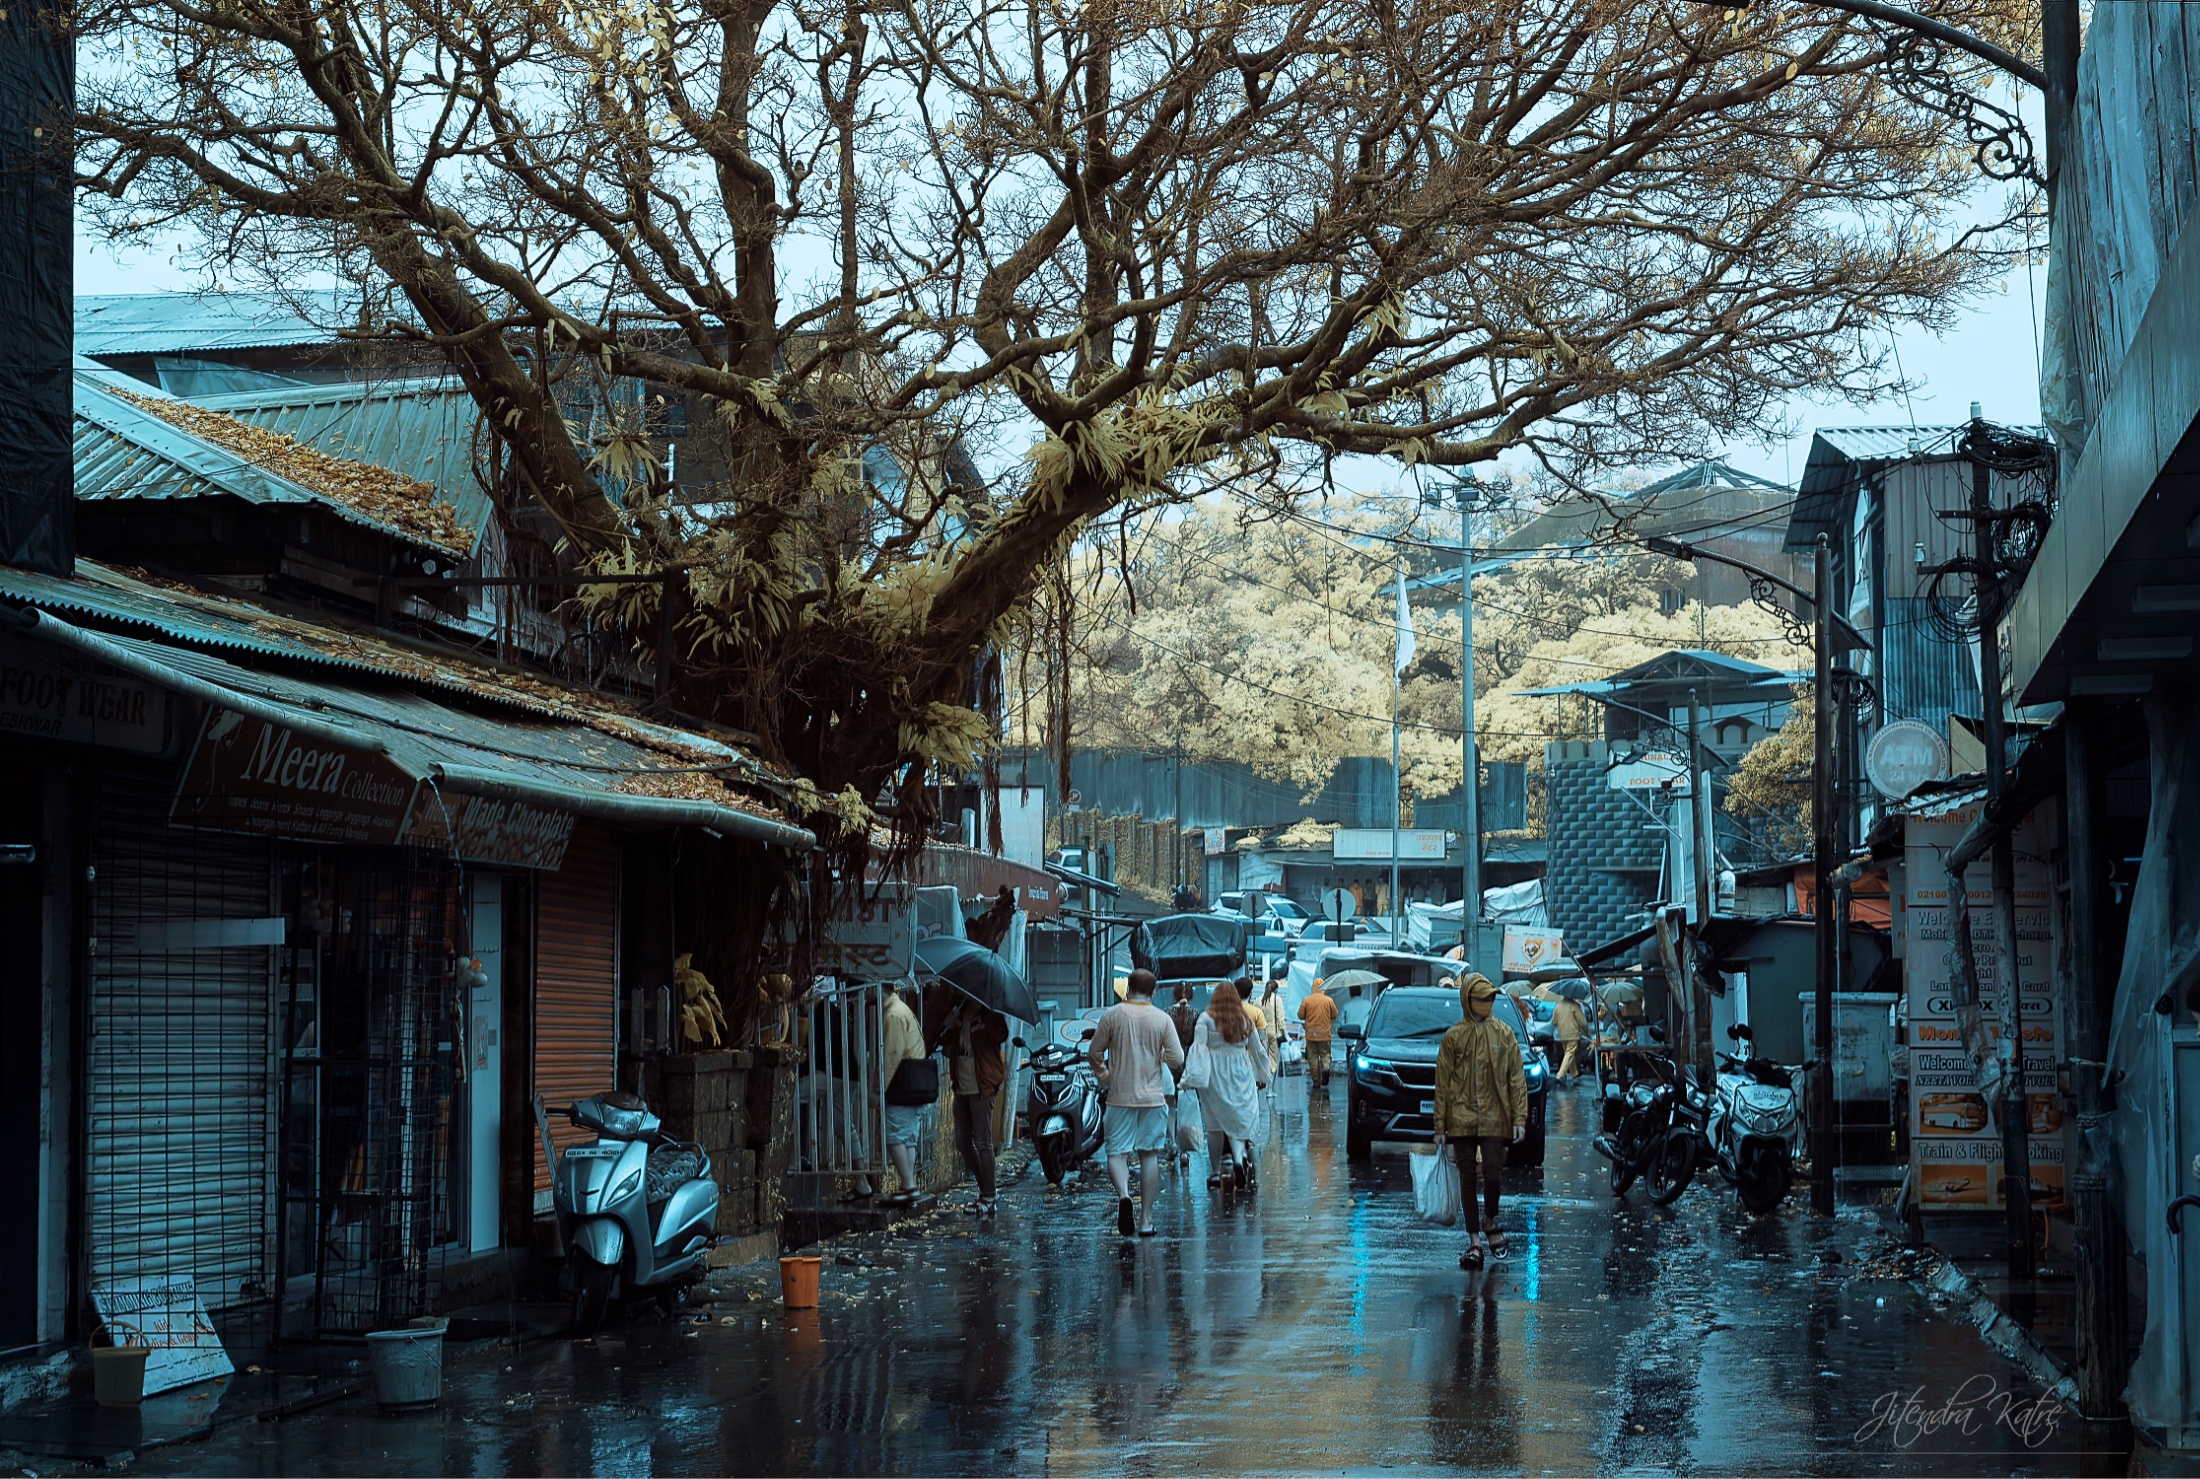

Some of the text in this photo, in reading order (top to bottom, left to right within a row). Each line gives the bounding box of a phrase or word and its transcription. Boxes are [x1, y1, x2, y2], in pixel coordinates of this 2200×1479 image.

[0, 665, 73, 718] FOOT
[78, 681, 146, 727] WEAR
[1641, 753, 1667, 761] UNAL
[1879, 743, 1933, 766] ATM
[239, 721, 405, 807] Meera Collection
[1630, 777, 1656, 786] FOOT
[461, 796, 506, 829] Made
[506, 801, 575, 841] Chocolate
[2021, 980, 2051, 992] Card
[1919, 1026, 1961, 1041] Mon
[1918, 1055, 1971, 1071] Welcome
[1918, 1143, 1953, 1160] Train
[1955, 1143, 1967, 1160] &
[1968, 1143, 2004, 1163] Fligh
